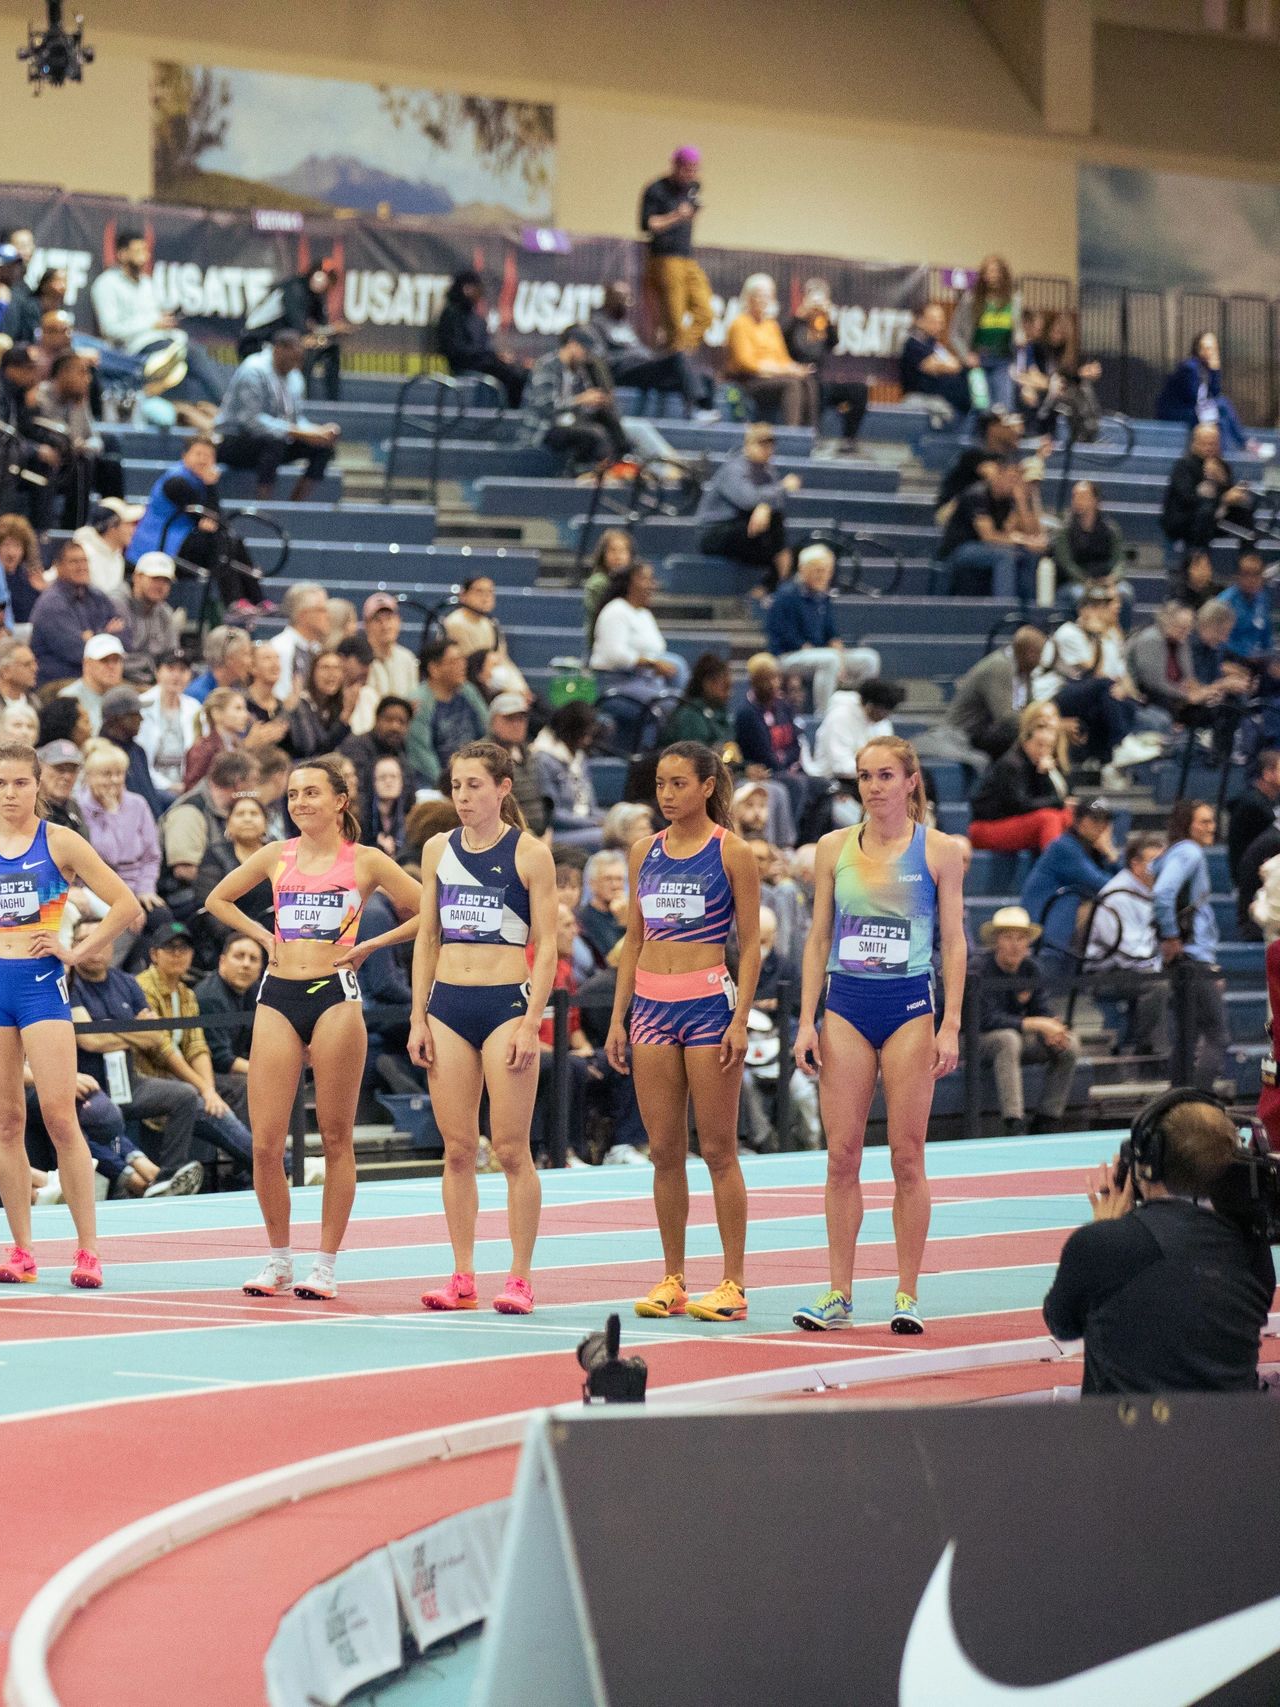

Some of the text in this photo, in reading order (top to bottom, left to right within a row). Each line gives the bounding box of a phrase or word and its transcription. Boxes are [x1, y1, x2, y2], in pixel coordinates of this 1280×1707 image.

[899, 874, 923, 882] HOKA
[658, 882, 702, 895] ABQ'24
[295, 893, 339, 907] ABQ'24
[457, 893, 500, 908] ABQ'24
[656, 897, 686, 909] GRAVES
[294, 909, 321, 922] DELAY
[450, 909, 486, 923] RANDALL
[861, 924, 906, 940] ABQ'24
[858, 940, 887, 954] SMITH
[345, 970, 359, 999] 9
[906, 1000, 927, 1011] HOKA
